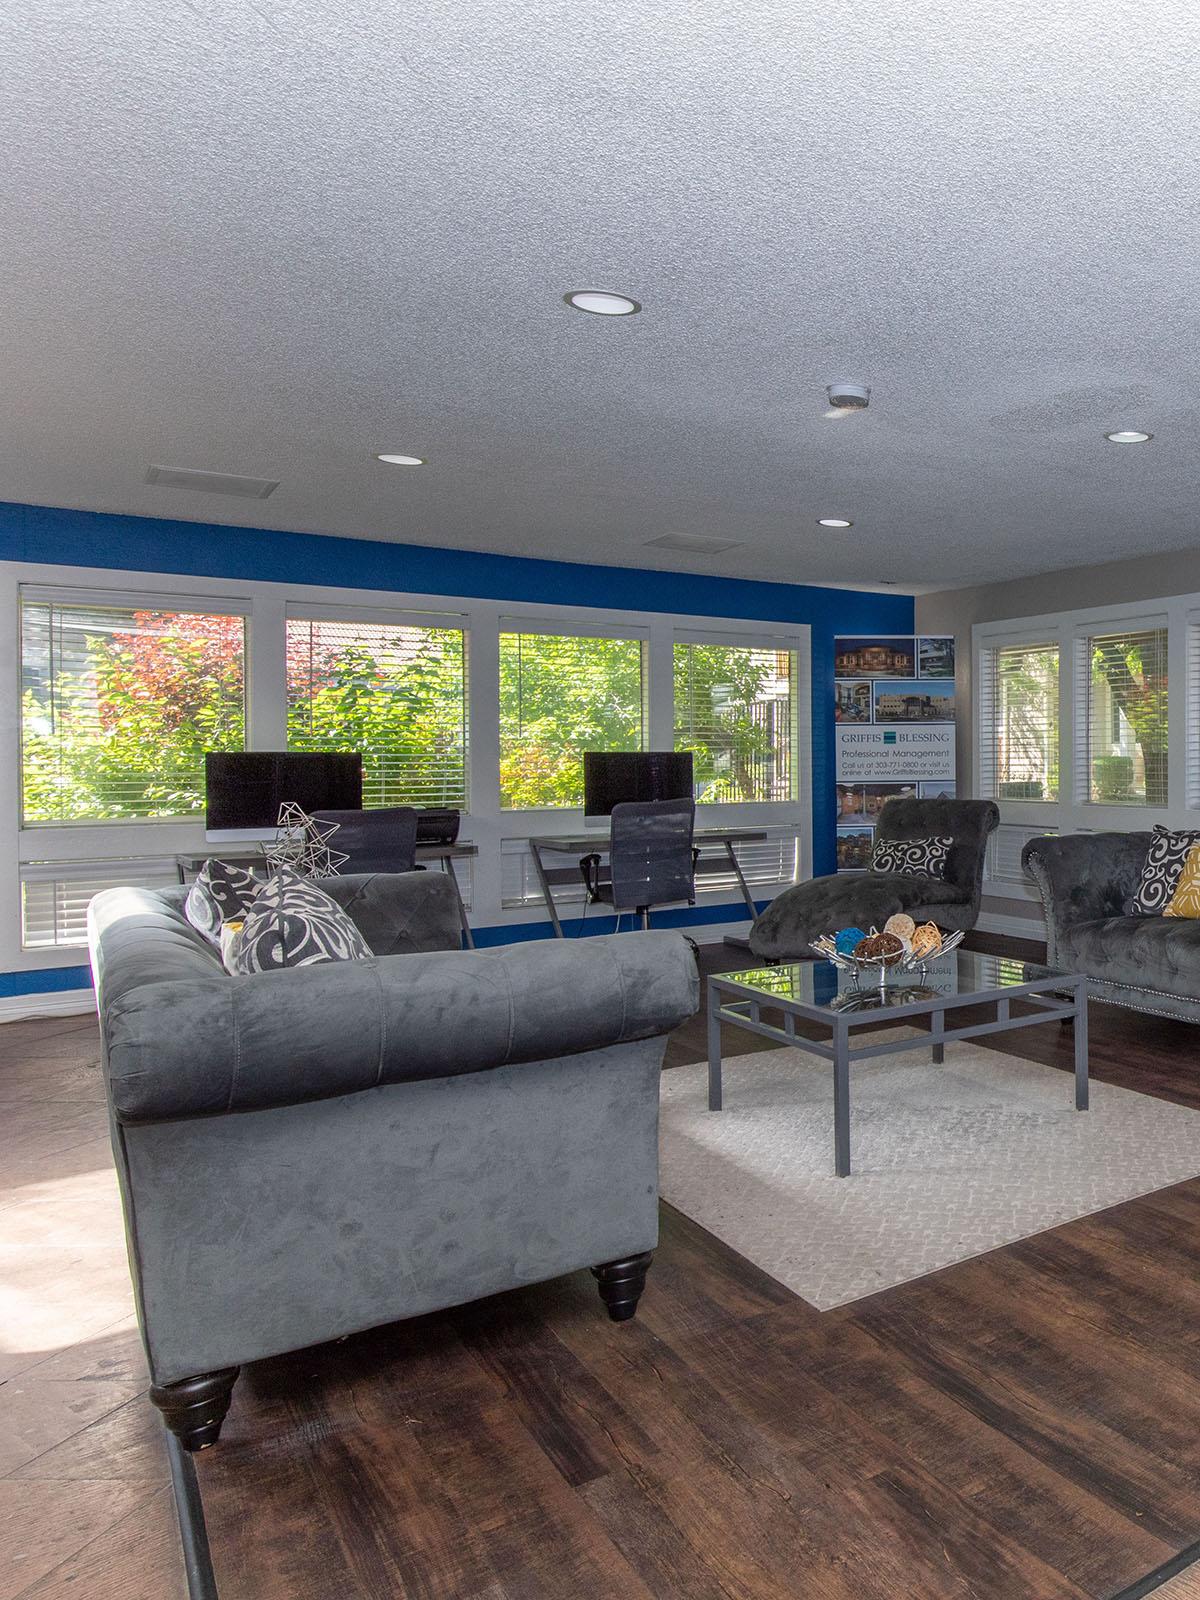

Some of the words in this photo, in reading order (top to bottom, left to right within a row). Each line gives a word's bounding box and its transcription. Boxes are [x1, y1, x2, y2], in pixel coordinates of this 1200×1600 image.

[841, 733, 881, 743] GRIFFIS
[899, 733, 950, 743] BLESSING
[841, 750, 889, 758] Professional
[892, 750, 949, 759] Management
